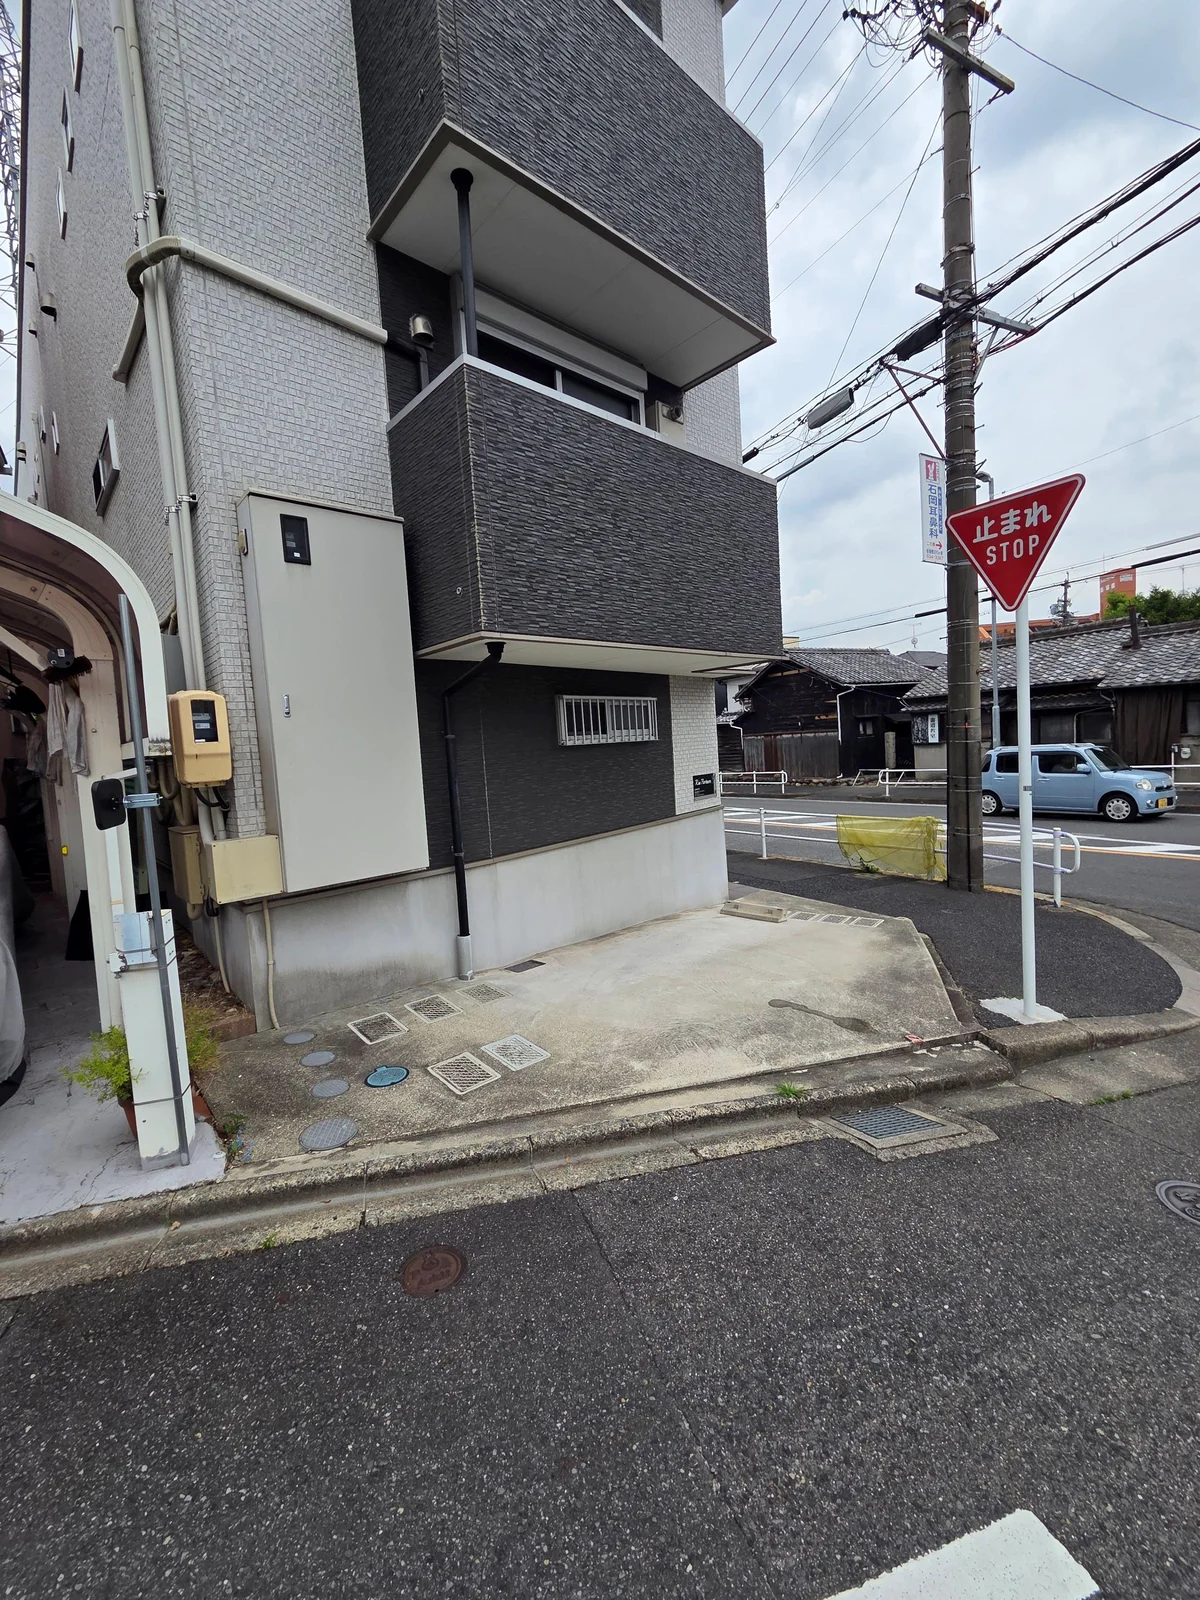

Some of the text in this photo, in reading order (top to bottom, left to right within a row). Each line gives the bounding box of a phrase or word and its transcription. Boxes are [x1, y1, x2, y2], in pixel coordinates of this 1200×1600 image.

[928, 483, 939, 539] 石岡耳鼻科
[973, 501, 1052, 544] 止まれ
[986, 535, 1040, 565] STOP
